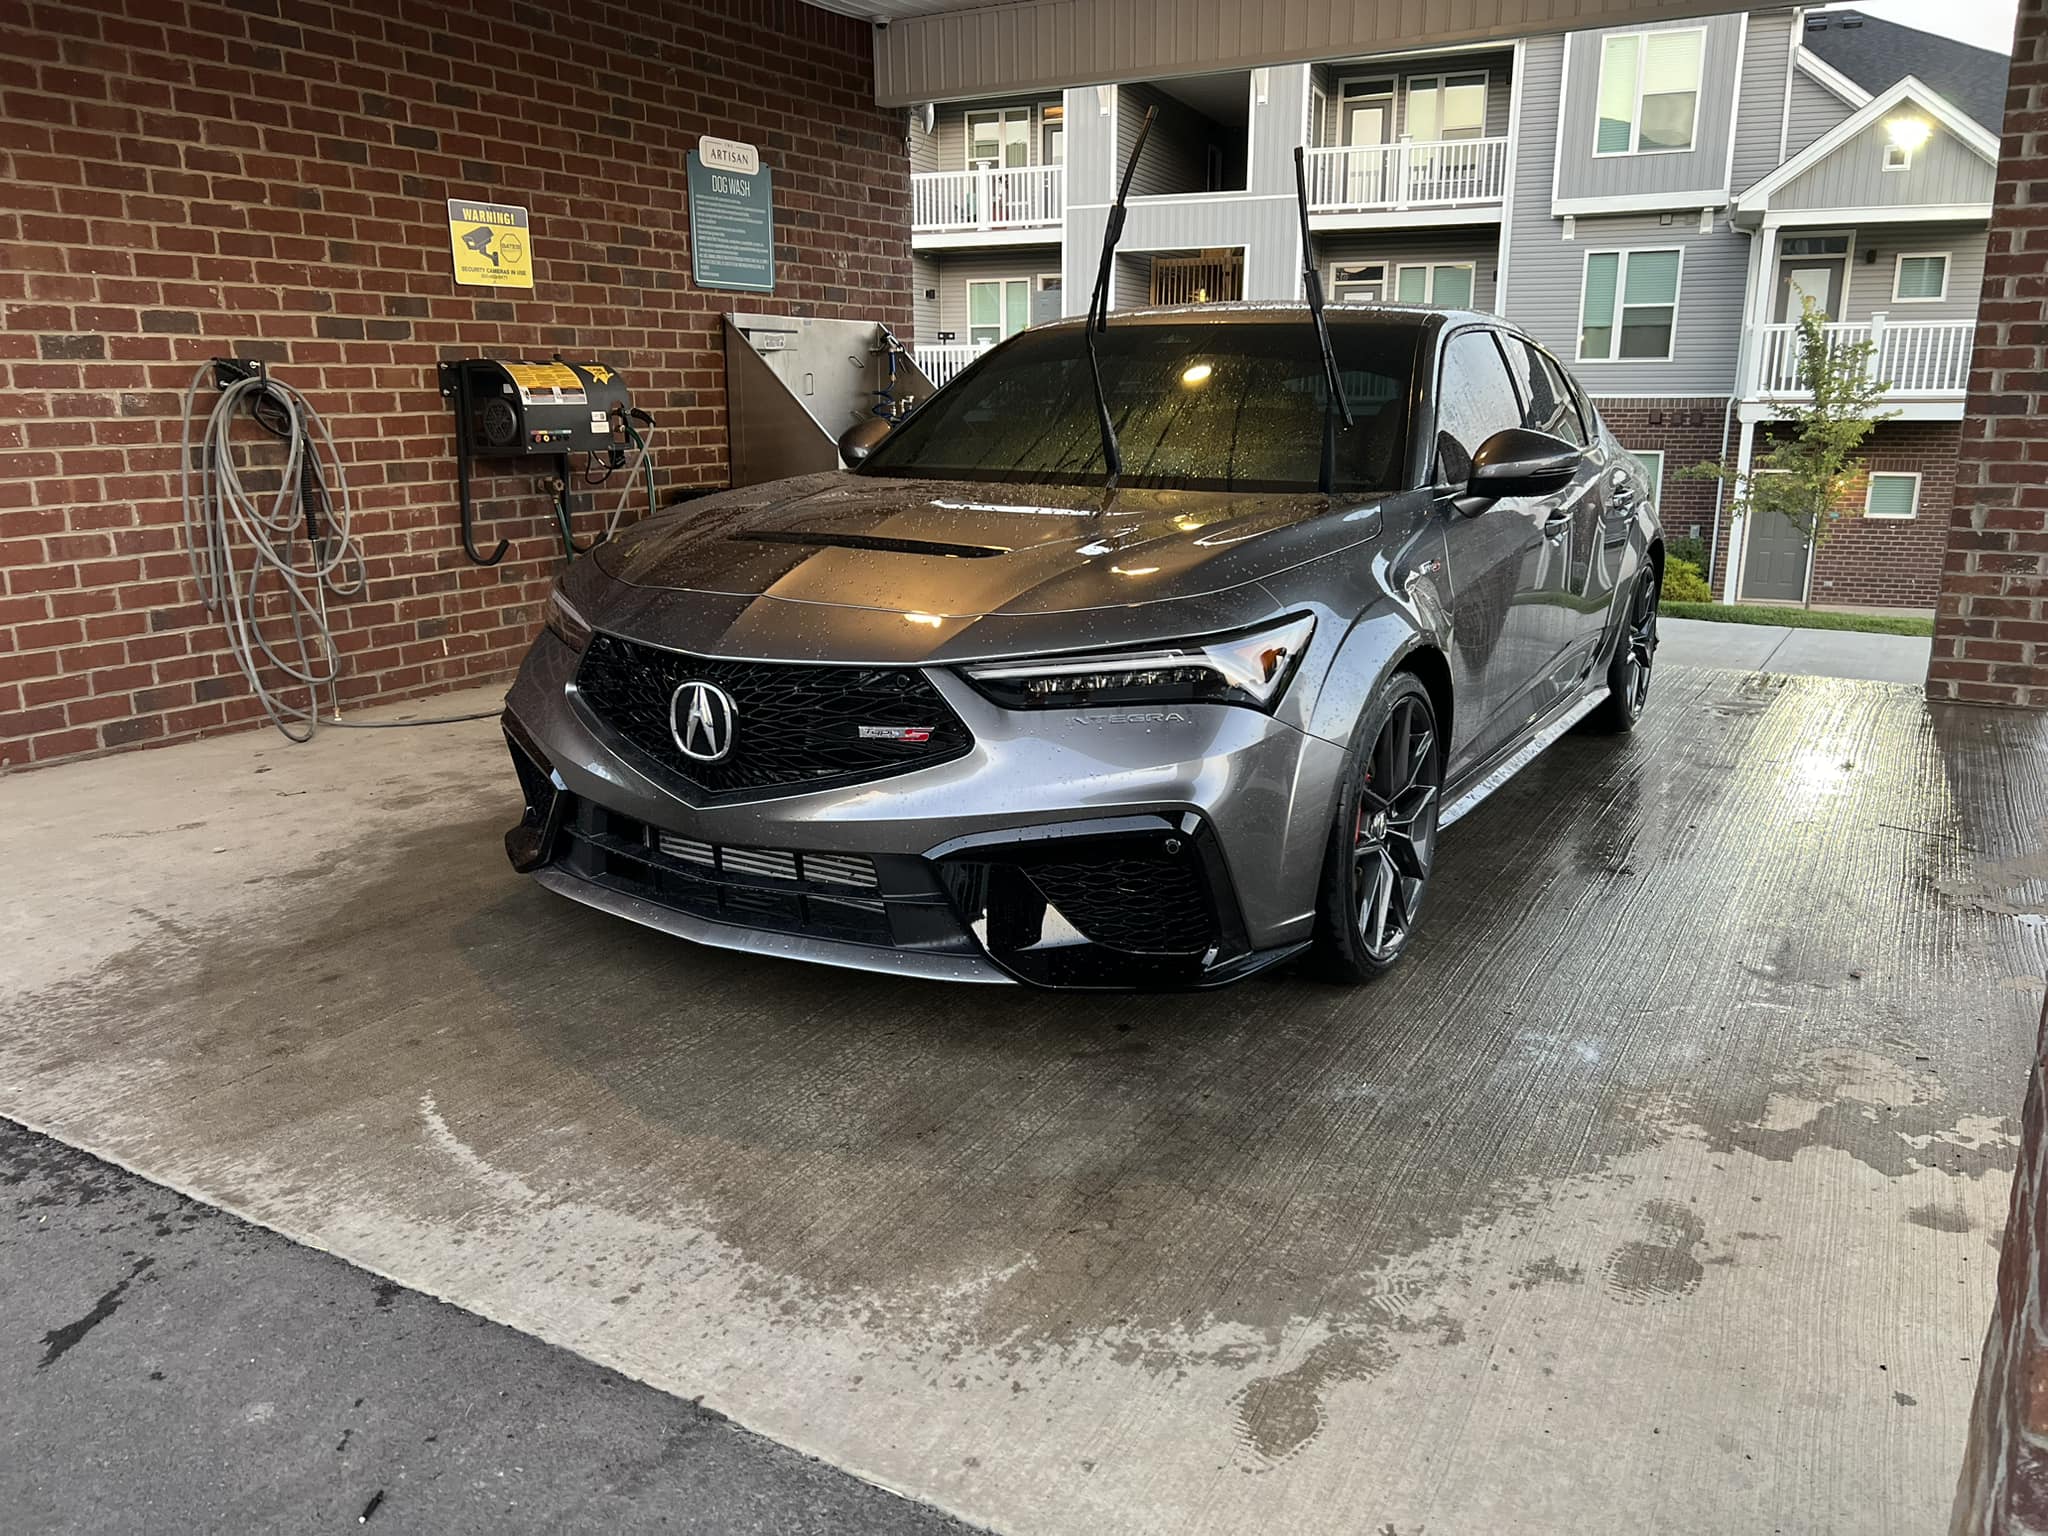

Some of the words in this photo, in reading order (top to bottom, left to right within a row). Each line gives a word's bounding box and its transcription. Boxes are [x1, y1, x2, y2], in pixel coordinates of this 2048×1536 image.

[711, 148, 749, 165] ARTISAN
[711, 174, 728, 195] DOG
[728, 177, 751, 197] WASH
[462, 207, 515, 225] WARNING!
[486, 267, 510, 275] CAMERAS
